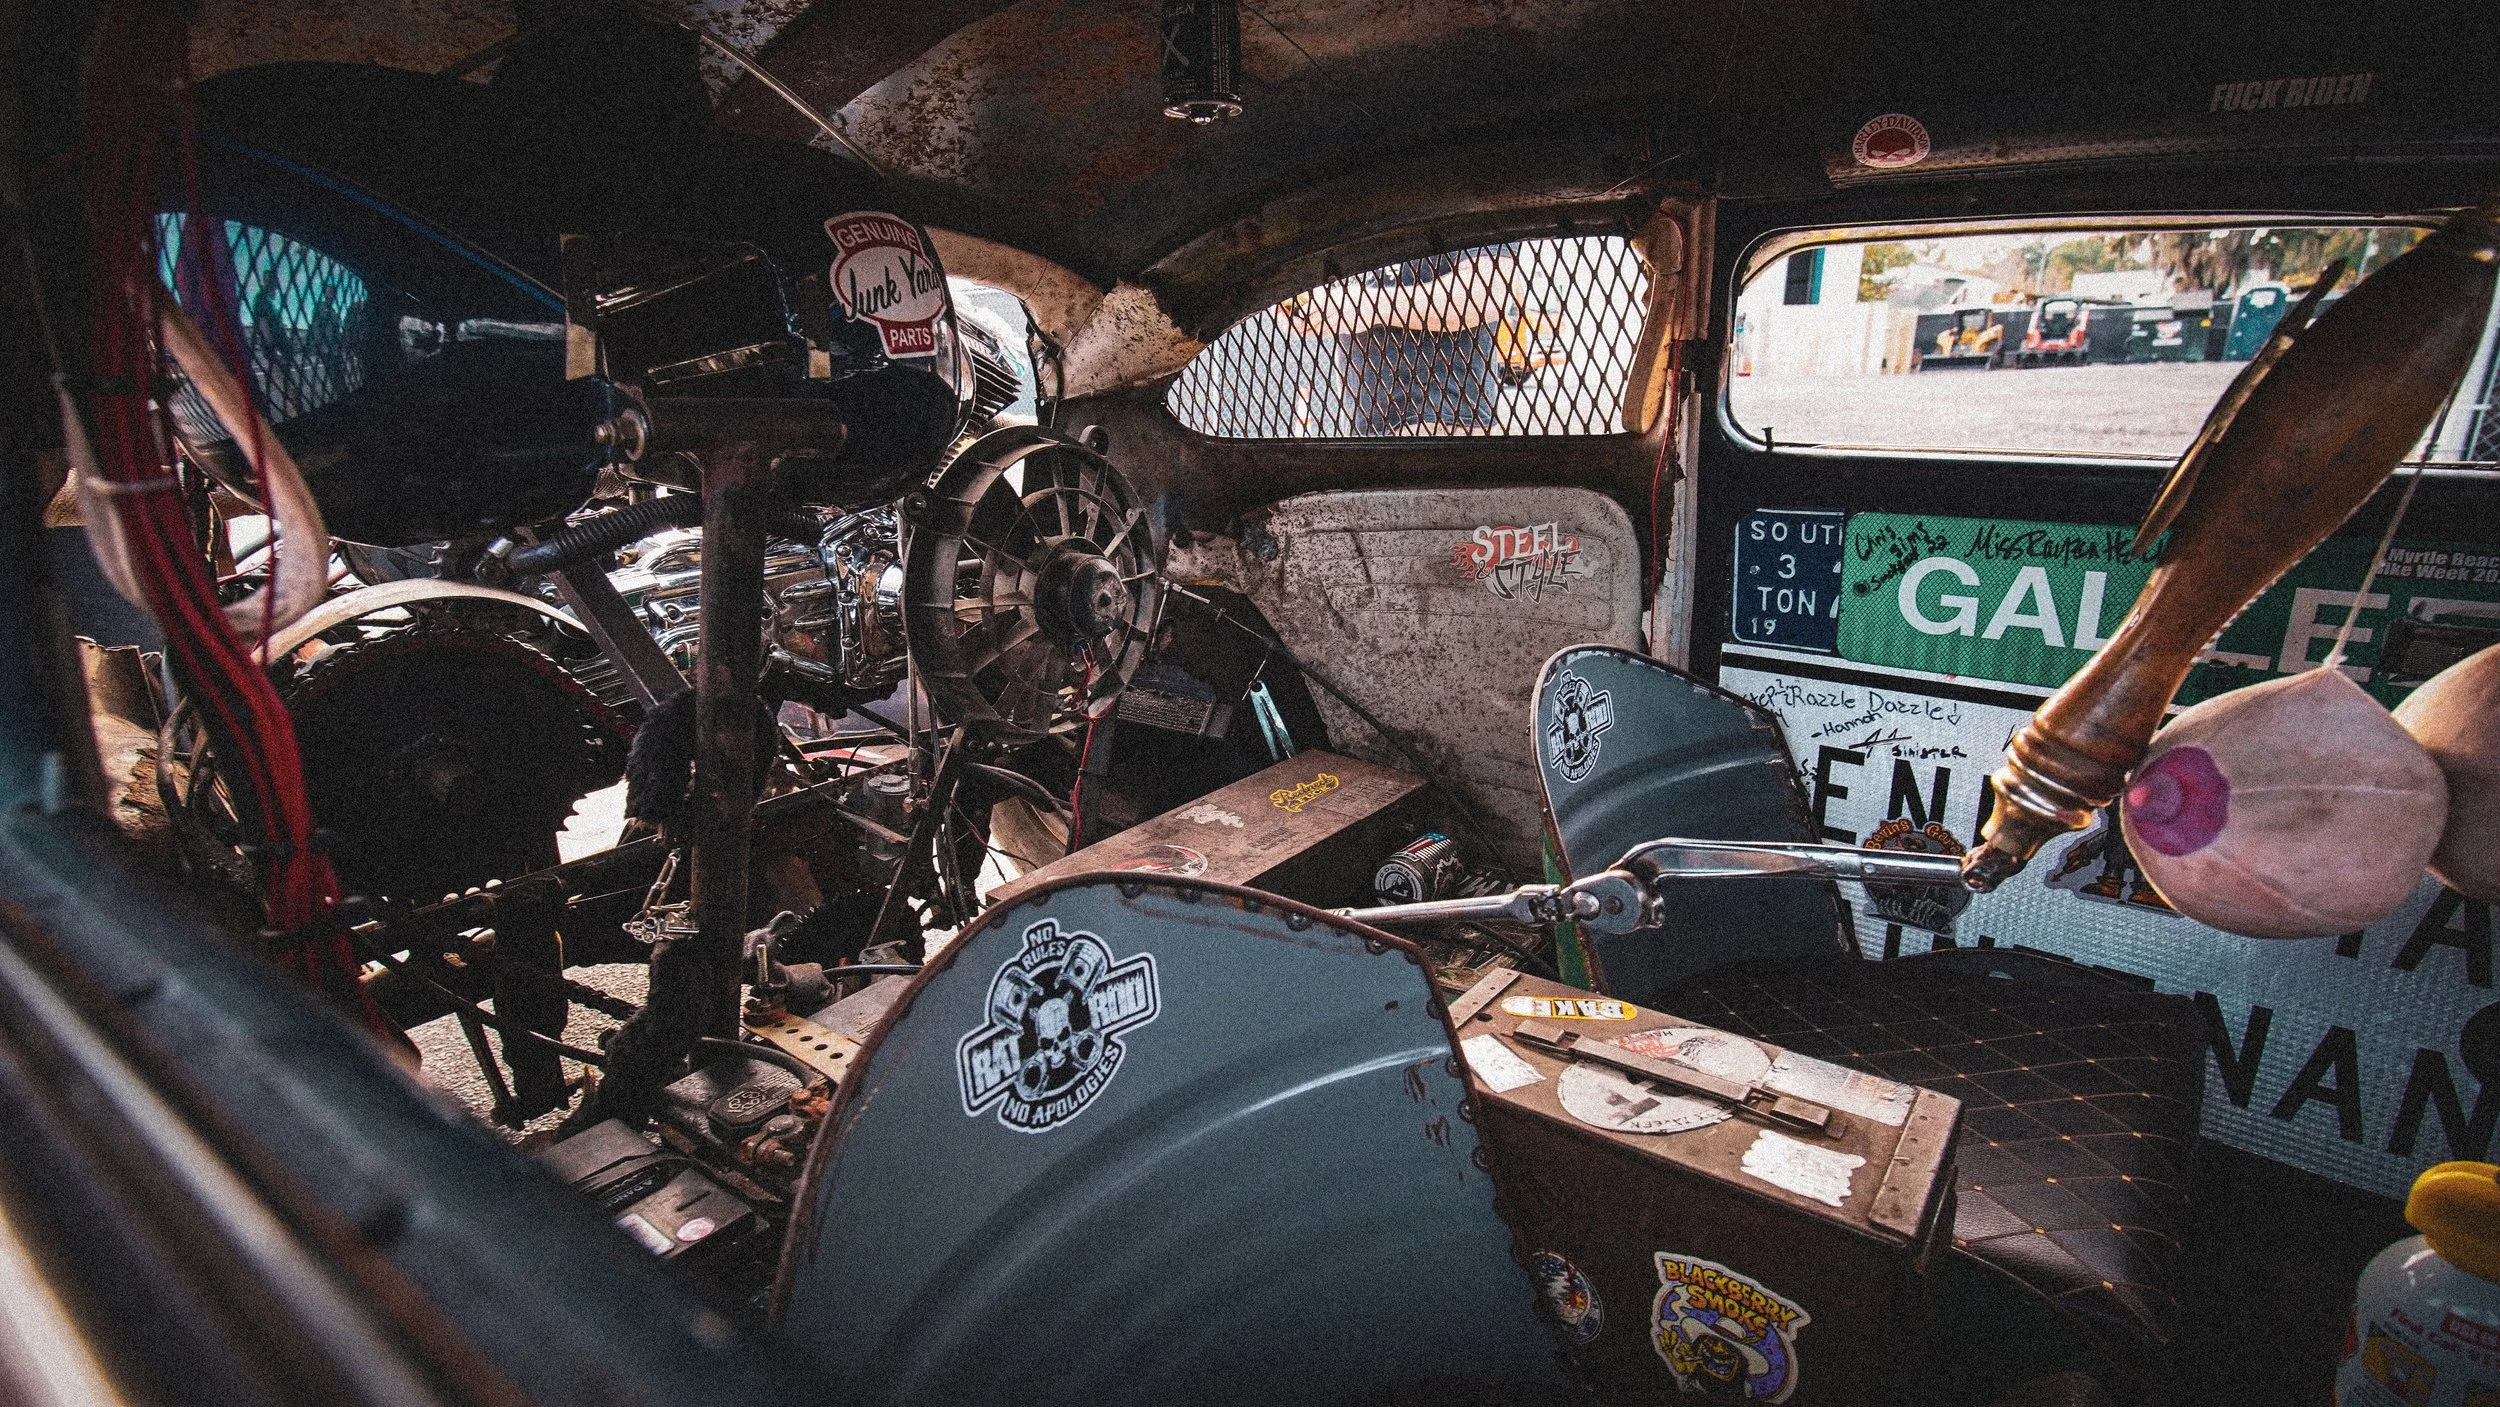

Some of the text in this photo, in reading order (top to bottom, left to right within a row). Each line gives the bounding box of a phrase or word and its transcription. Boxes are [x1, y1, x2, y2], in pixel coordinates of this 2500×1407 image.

[2209, 79, 2286, 113] FUCK
[836, 221, 917, 250] GENUINE
[842, 265, 902, 321] Junk
[890, 327, 932, 348] PARTS
[1471, 520, 1573, 564] STEEL
[1777, 554, 1796, 579] 3
[2376, 563, 2412, 578] ike
[2416, 564, 2469, 581] Week
[2387, 549, 2500, 568] Myrtle Beac
[1492, 547, 1583, 605] STYLE
[1757, 586, 1817, 616] TON
[1751, 617, 1777, 636] 19
[1029, 926, 1054, 947] NO
[1021, 940, 1066, 971] RULES
[972, 972, 1148, 1093] RAT ROD
[1004, 1044, 1120, 1125] NO APOLOGIES
[1663, 1259, 1799, 1330] BLACKBERRY
[1687, 1284, 1768, 1338] SMOKE
